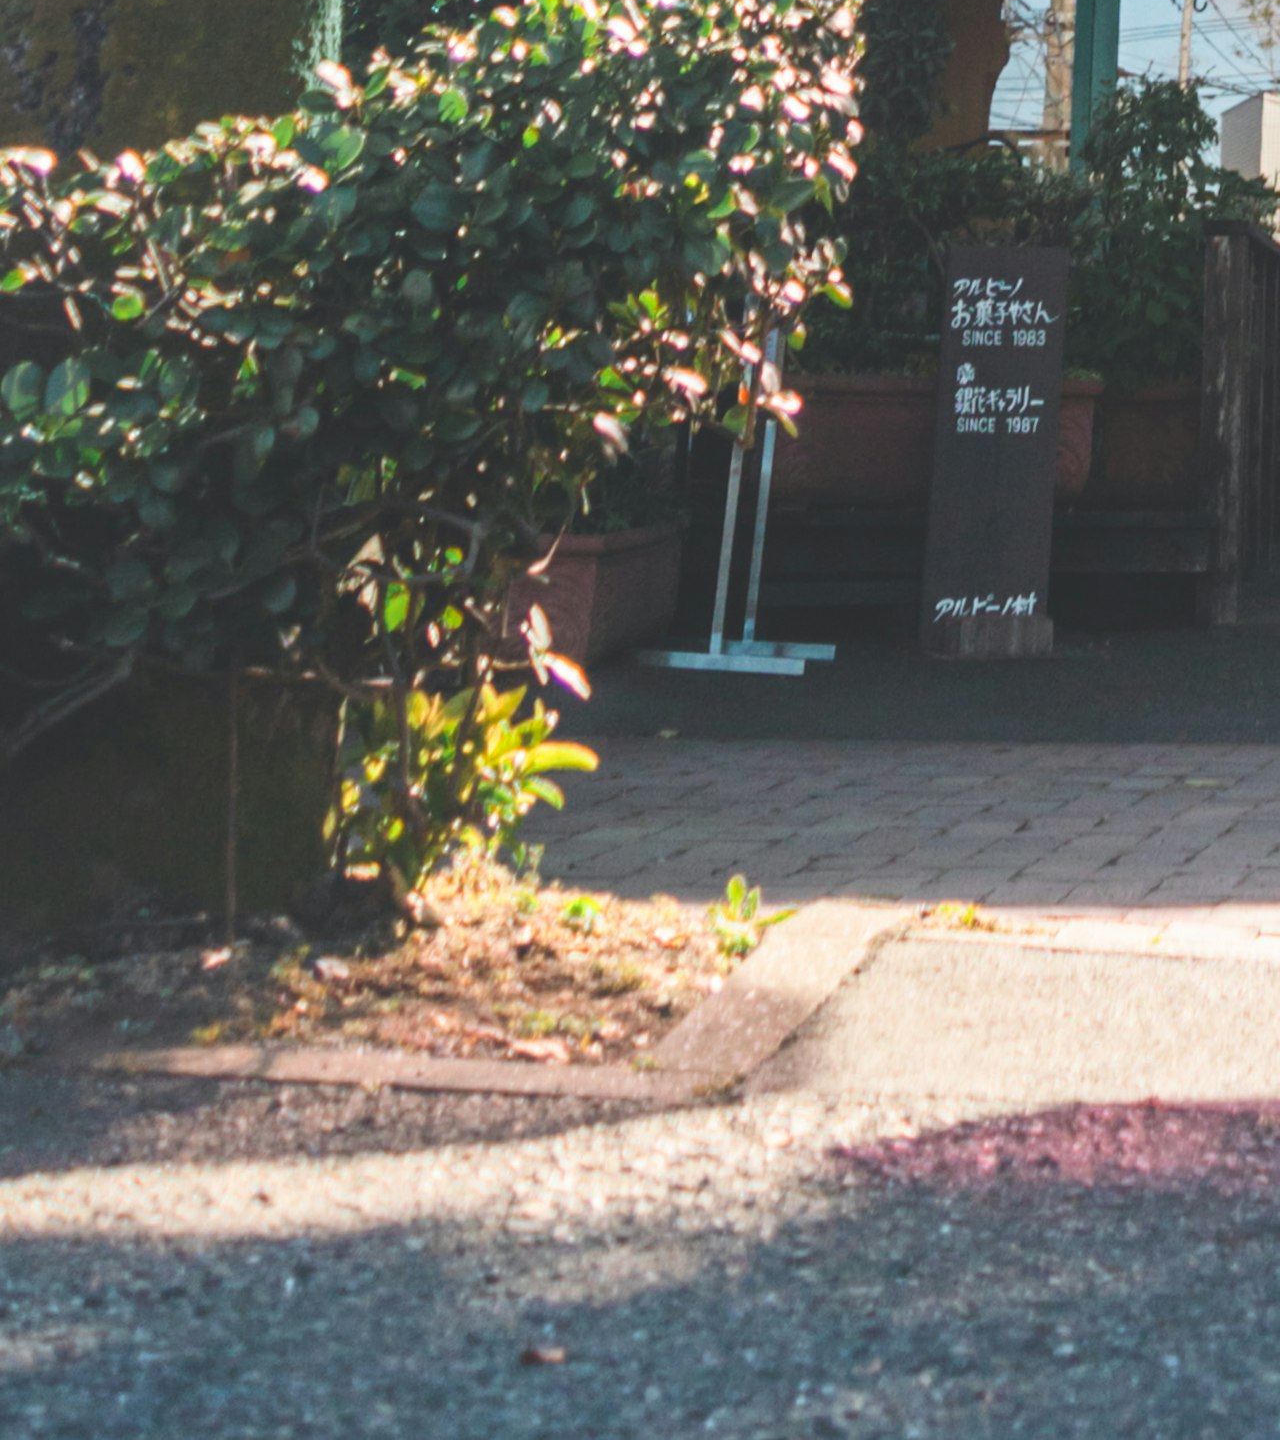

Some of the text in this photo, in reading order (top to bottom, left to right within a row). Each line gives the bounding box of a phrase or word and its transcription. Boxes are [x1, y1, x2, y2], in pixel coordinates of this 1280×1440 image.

[953, 277, 1024, 299] アルピーノ
[951, 298, 1060, 329] お菓子やさん
[961, 330, 1046, 346] SINCE 1983
[954, 385, 1045, 415] 銀花ギャラリー
[956, 417, 1040, 433] SINCE 1987
